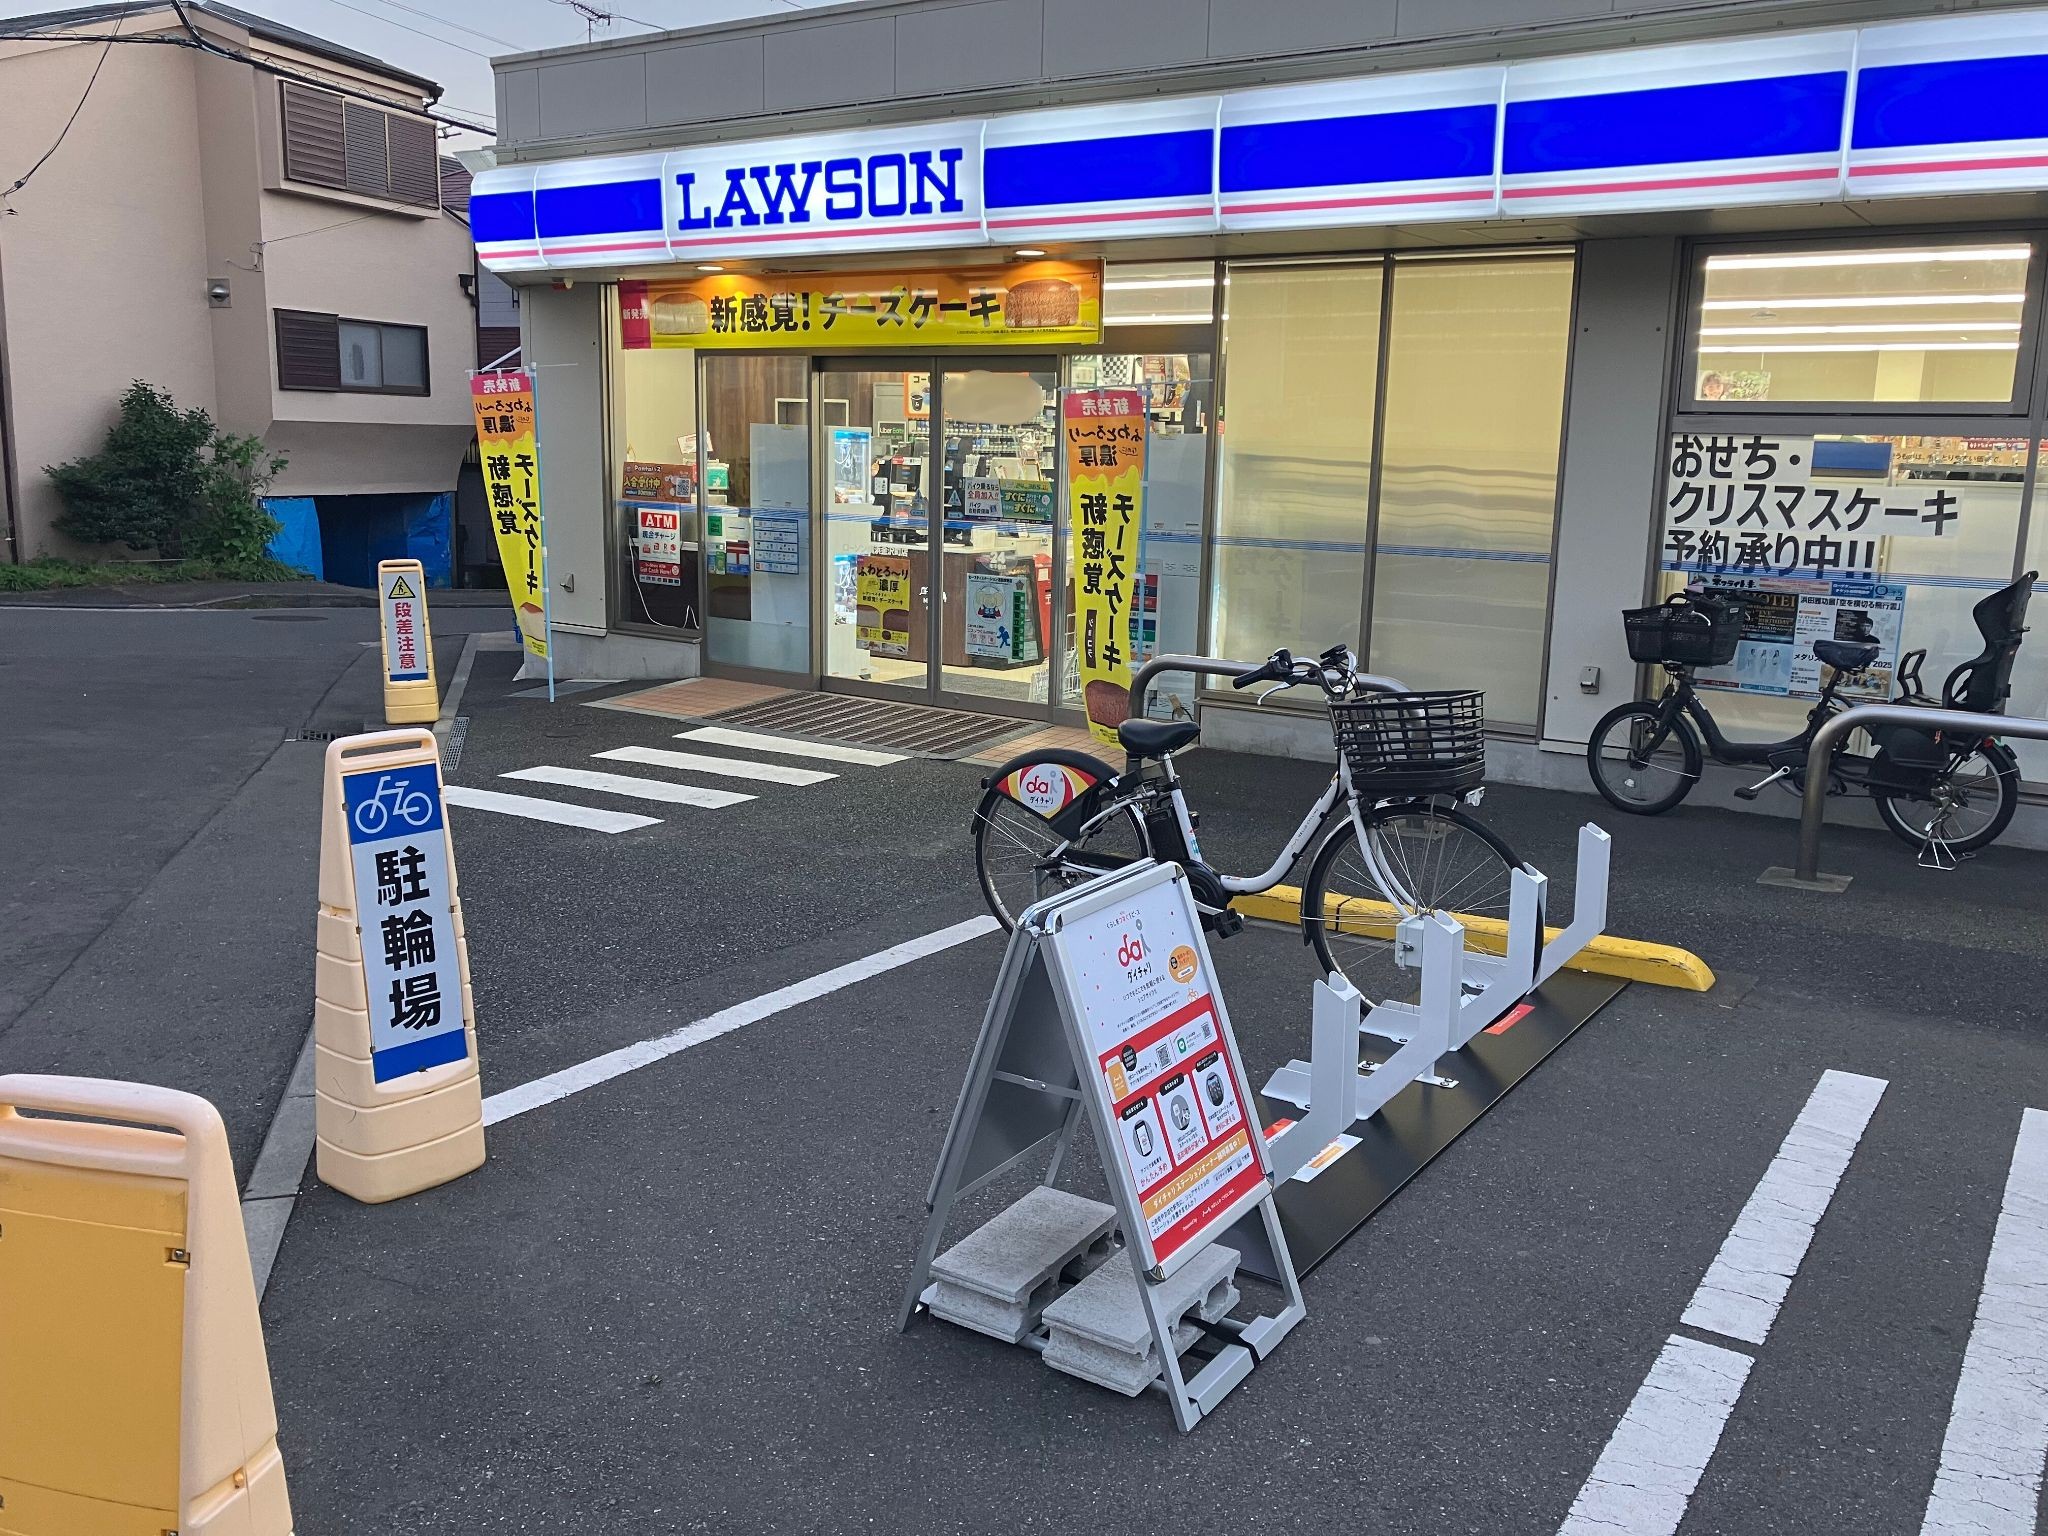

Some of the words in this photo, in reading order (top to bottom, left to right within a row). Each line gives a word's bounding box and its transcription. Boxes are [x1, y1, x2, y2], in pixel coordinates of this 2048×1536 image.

[676, 148, 963, 230] LAWSON
[623, 308, 648, 320] 新発売
[645, 514, 673, 529] ATM
[1669, 482, 1958, 536] クリスマスケーキ
[642, 530, 676, 541] 現金チャージ
[1664, 529, 1876, 580] 予約承り中!!
[394, 601, 417, 670] 段差注意
[1872, 661, 1893, 669] 2025
[375, 844, 442, 1032] 駐輪場
[1127, 962, 1153, 983] ダイチャリ
